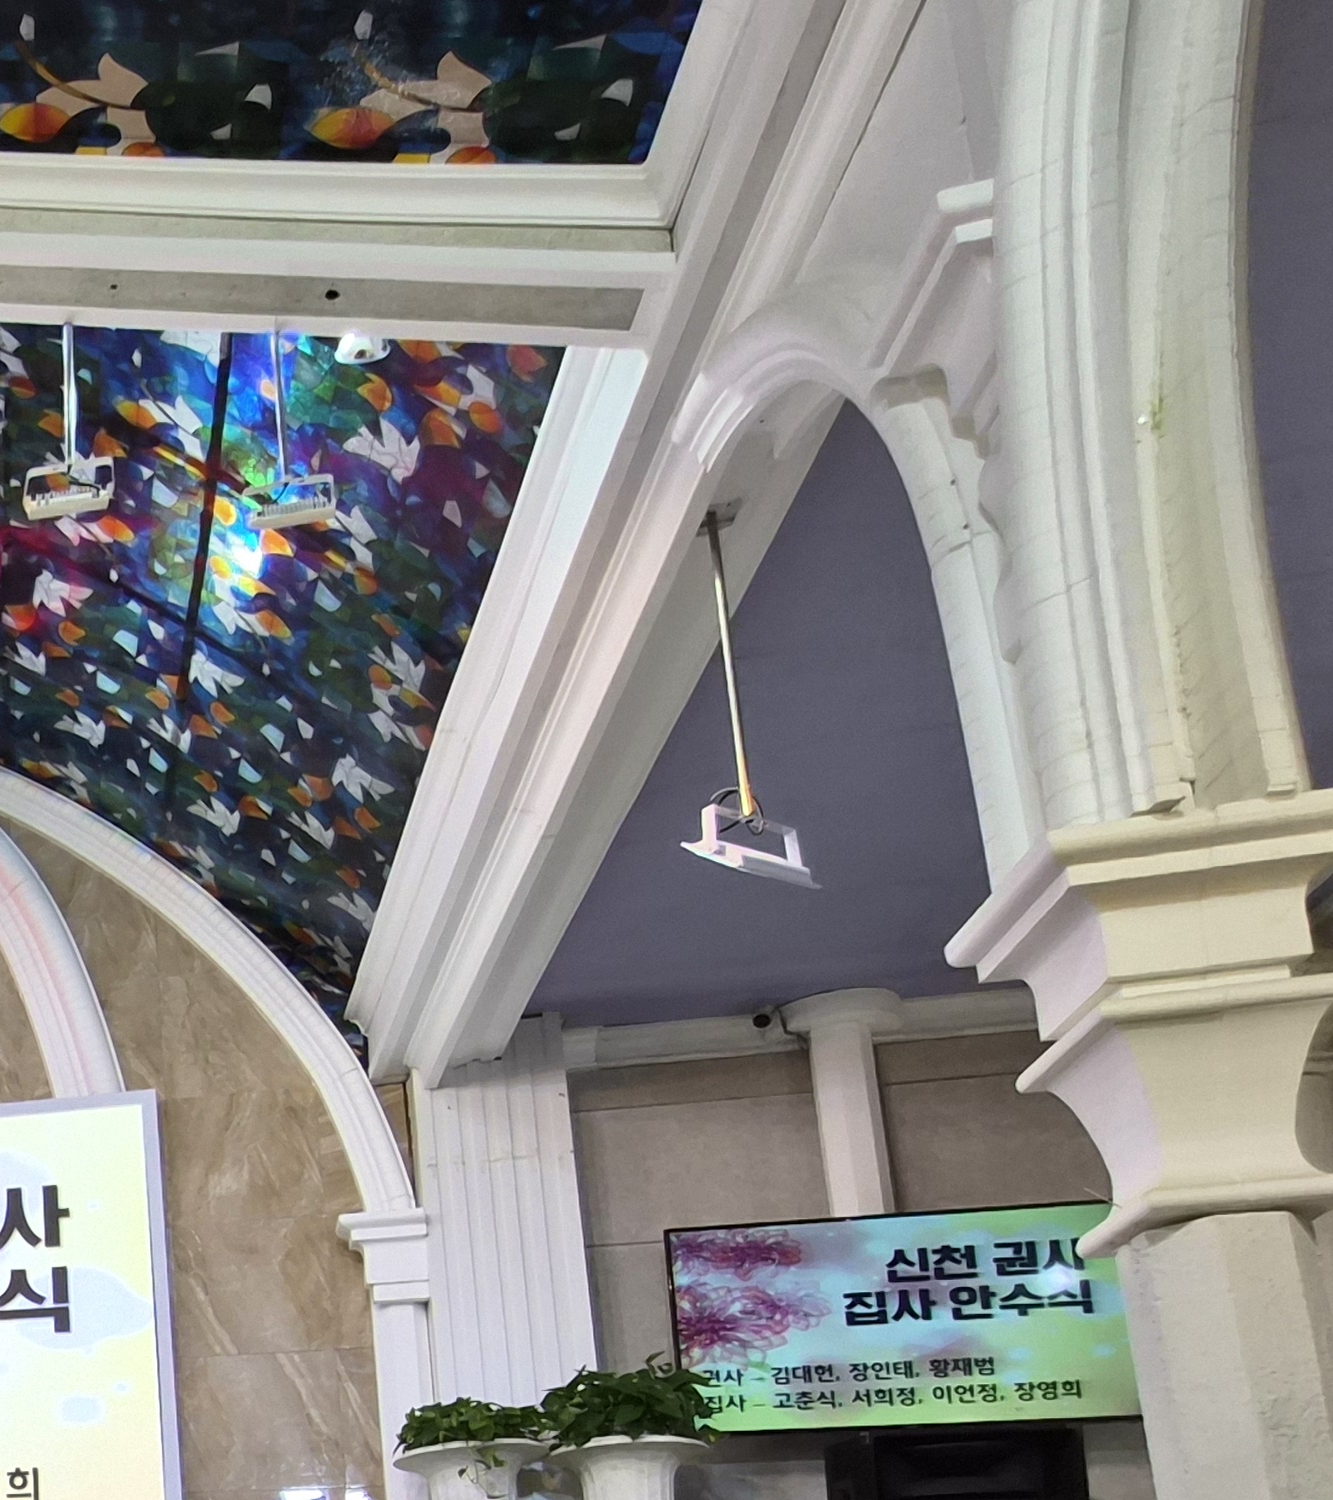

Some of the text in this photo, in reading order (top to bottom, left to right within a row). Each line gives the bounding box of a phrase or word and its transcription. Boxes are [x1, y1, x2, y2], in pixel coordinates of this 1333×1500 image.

[885, 1237, 1085, 1284] 신천 권사
[843, 1279, 1095, 1327] 집사 안수식
[771, 1364, 840, 1385] 김대헌,
[848, 1360, 920, 1381] 장인태,
[928, 1357, 995, 1378] 황재범
[704, 1393, 747, 1414] 집사
[772, 1390, 843, 1411] 고춘식,
[851, 1386, 923, 1409] 서희정,
[932, 1383, 1004, 1405] 이언정,
[1013, 1379, 1082, 1401] 장영희
